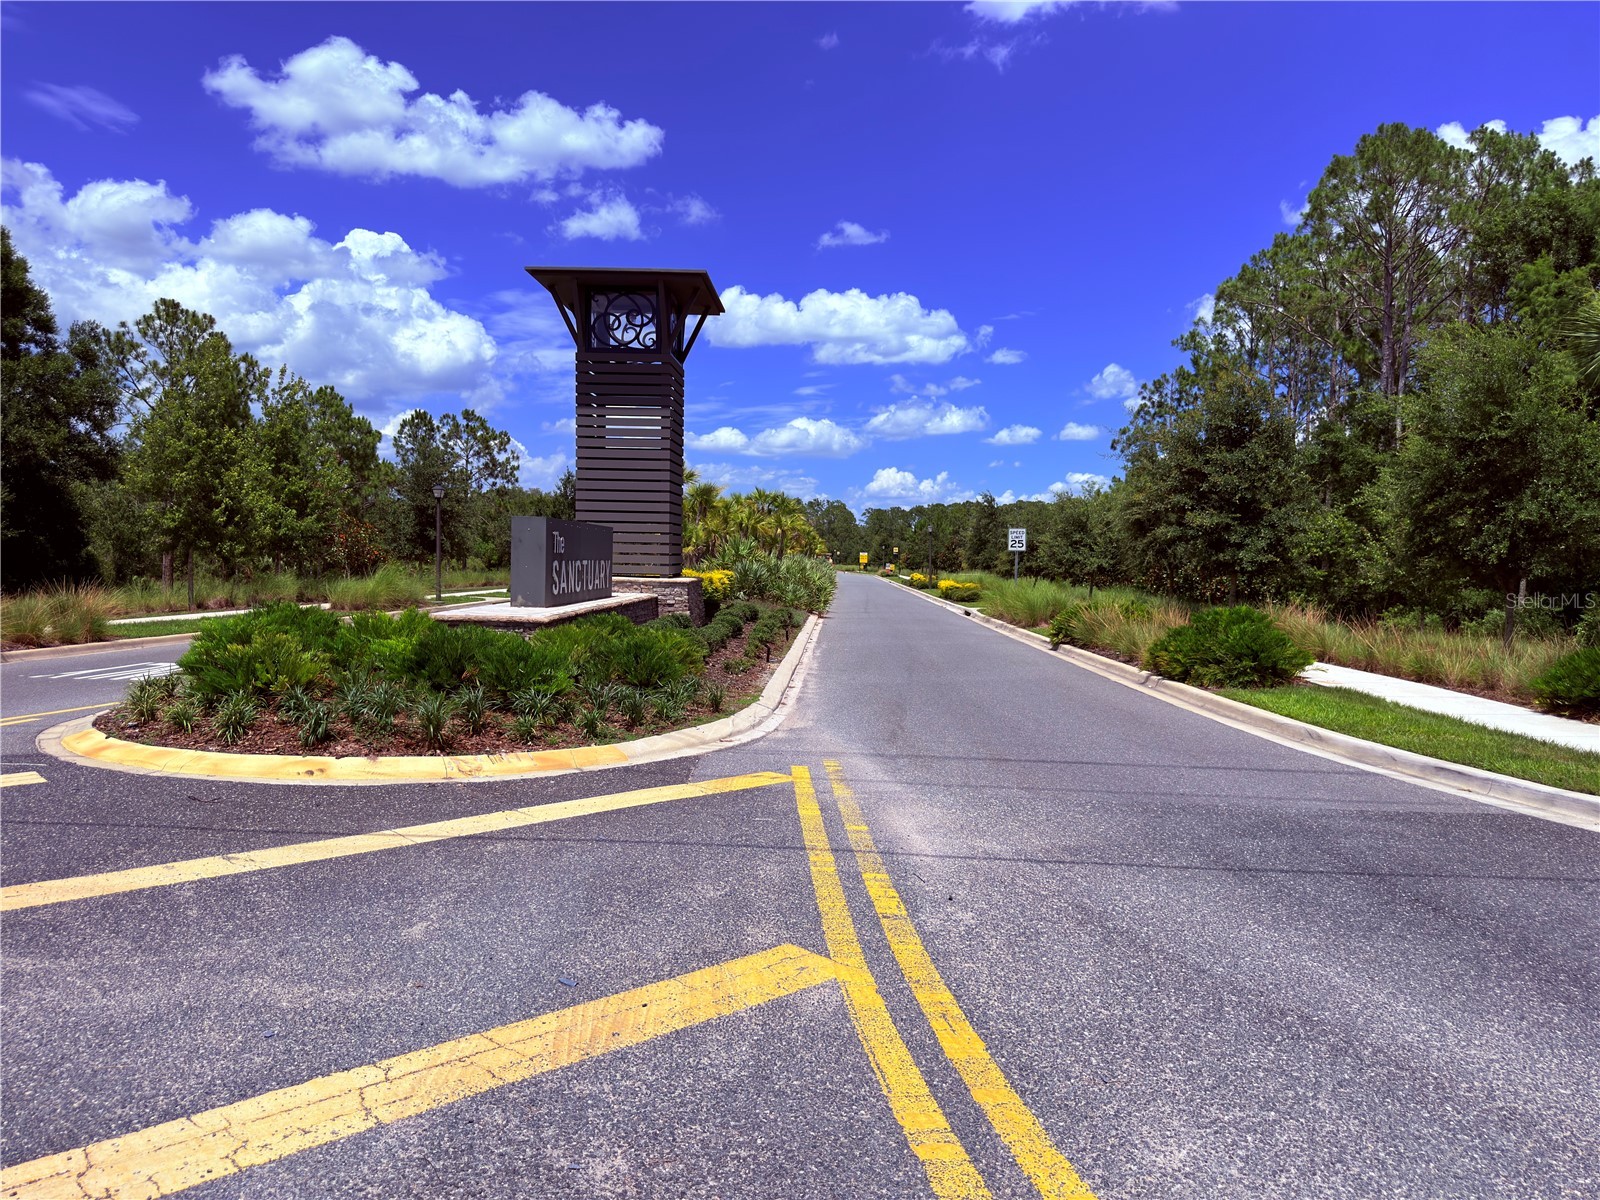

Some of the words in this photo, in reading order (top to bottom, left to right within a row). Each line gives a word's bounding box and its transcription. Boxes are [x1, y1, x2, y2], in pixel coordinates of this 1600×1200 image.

[552, 531, 565, 554] The
[1010, 540, 1024, 548] 25
[552, 559, 611, 595] SANCTUARY
